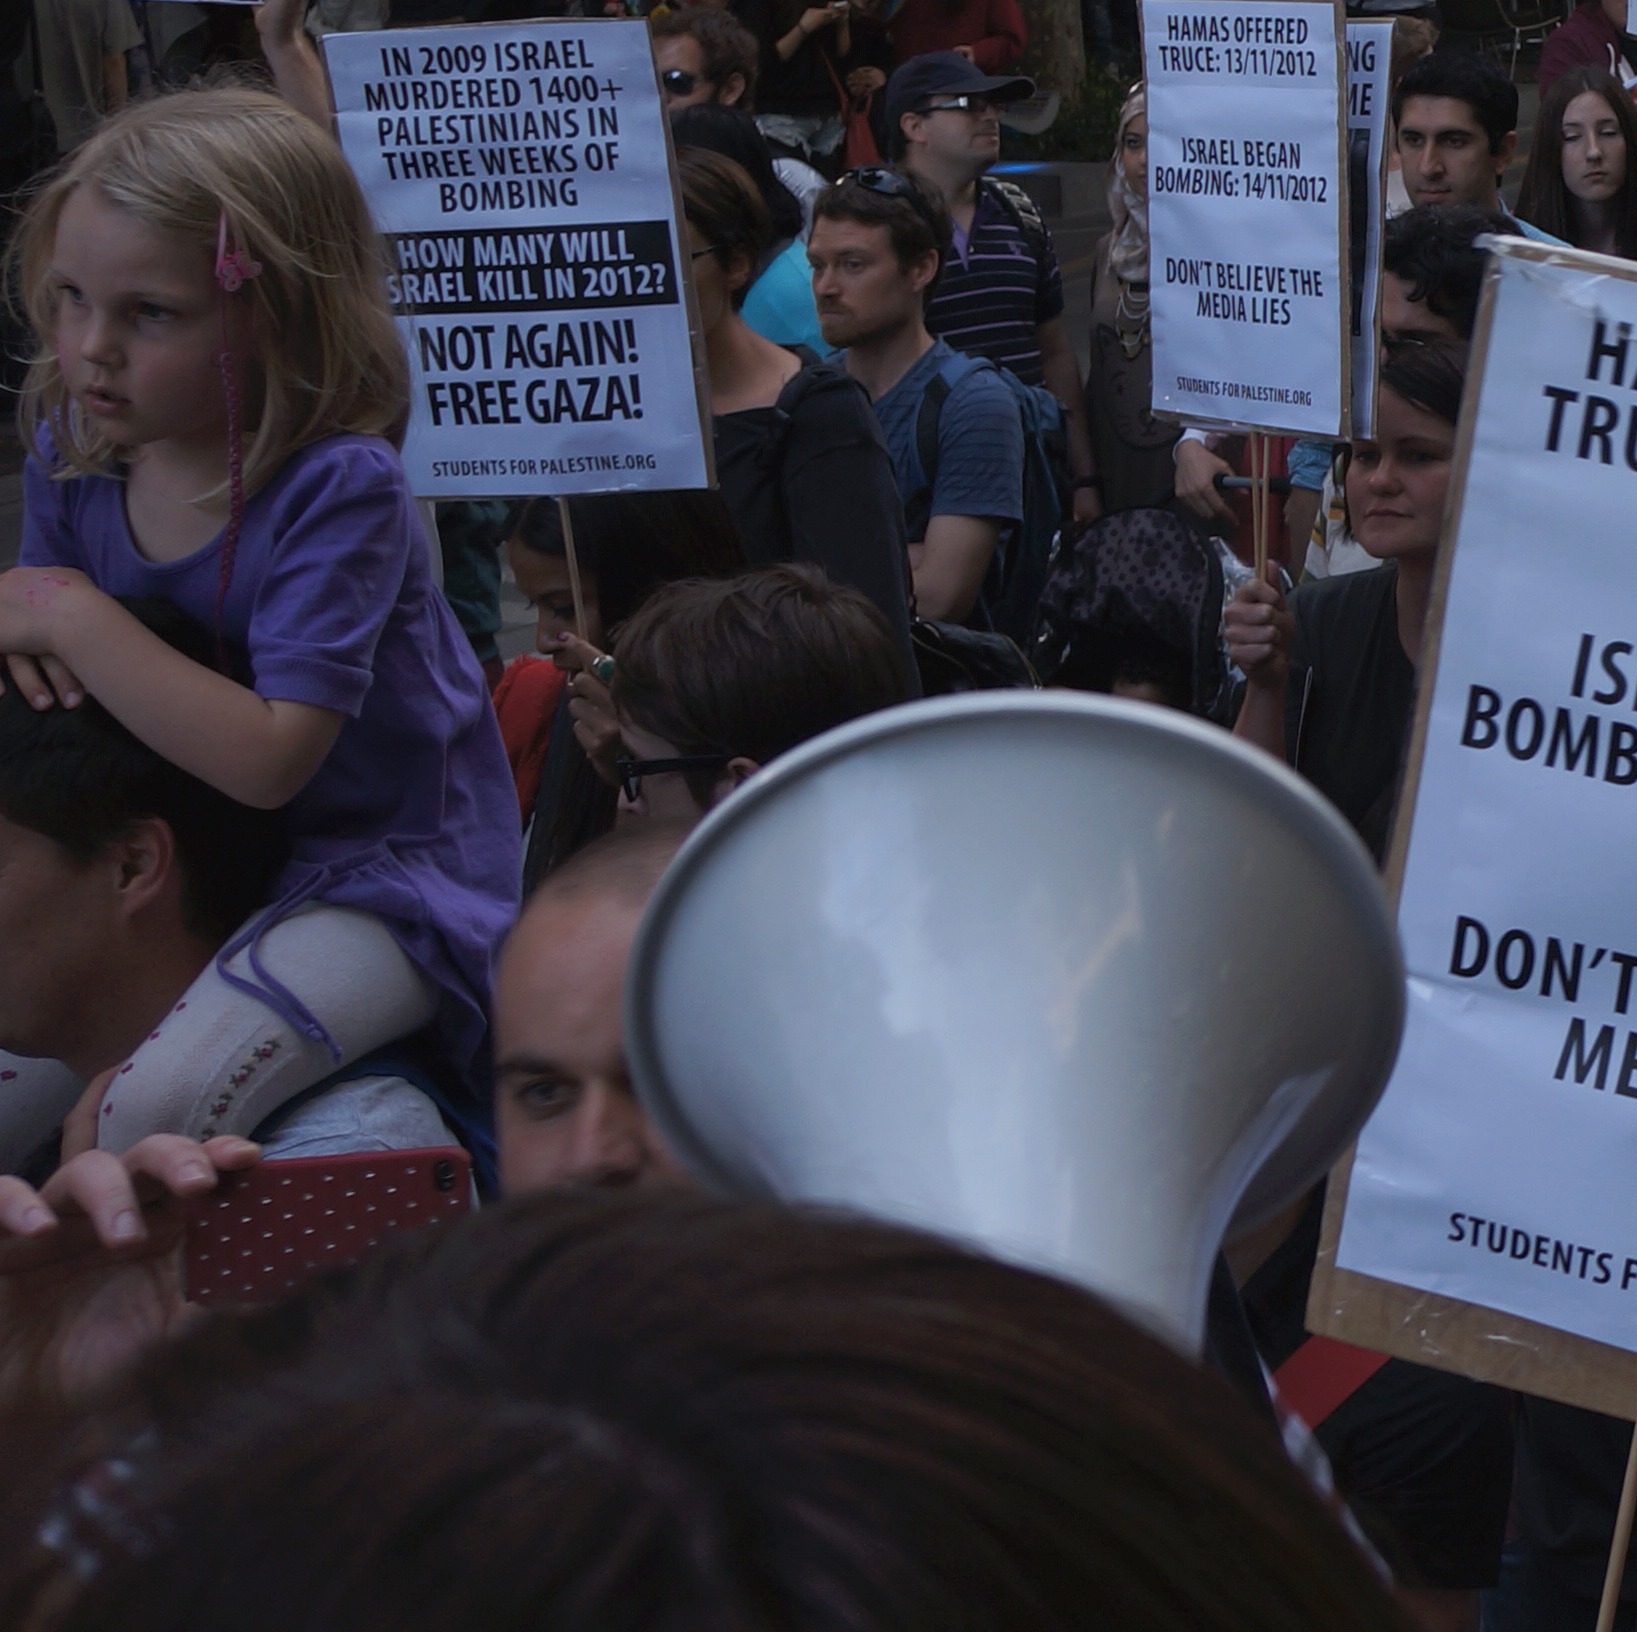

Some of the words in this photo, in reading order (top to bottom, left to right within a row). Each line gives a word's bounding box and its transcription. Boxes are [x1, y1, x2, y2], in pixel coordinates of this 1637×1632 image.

[382, 47, 412, 77] IN
[420, 44, 487, 74] 2009
[496, 39, 594, 72] ISRAEL
[364, 80, 521, 112] MURDERED
[530, 75, 624, 104] 1400+
[378, 109, 578, 146] PALESTINIANS
[588, 106, 619, 137] IN
[383, 149, 481, 180] THREE
[478, 145, 577, 176] WEEKS
[585, 142, 620, 171] OF
[439, 178, 578, 212] BOMBING
[398, 236, 465, 270] HOW
[474, 232, 555, 266] MANY
[560, 229, 635, 263] WILL
[386, 272, 472, 306] SRAEL
[478, 269, 539, 303] KILL
[545, 267, 576, 300] IN
[583, 262, 667, 298] 2012?
[419, 325, 495, 372] NOT
[505, 318, 639, 369] AGAIN!
[428, 380, 521, 426] FREE
[526, 374, 644, 425] GAZA!
[433, 459, 507, 478] STUDENTS
[510, 459, 537, 475] FOR
[540, 454, 657, 475] PALESTINE.ORG
[1448, 1210, 1613, 1288] STUDENTS
